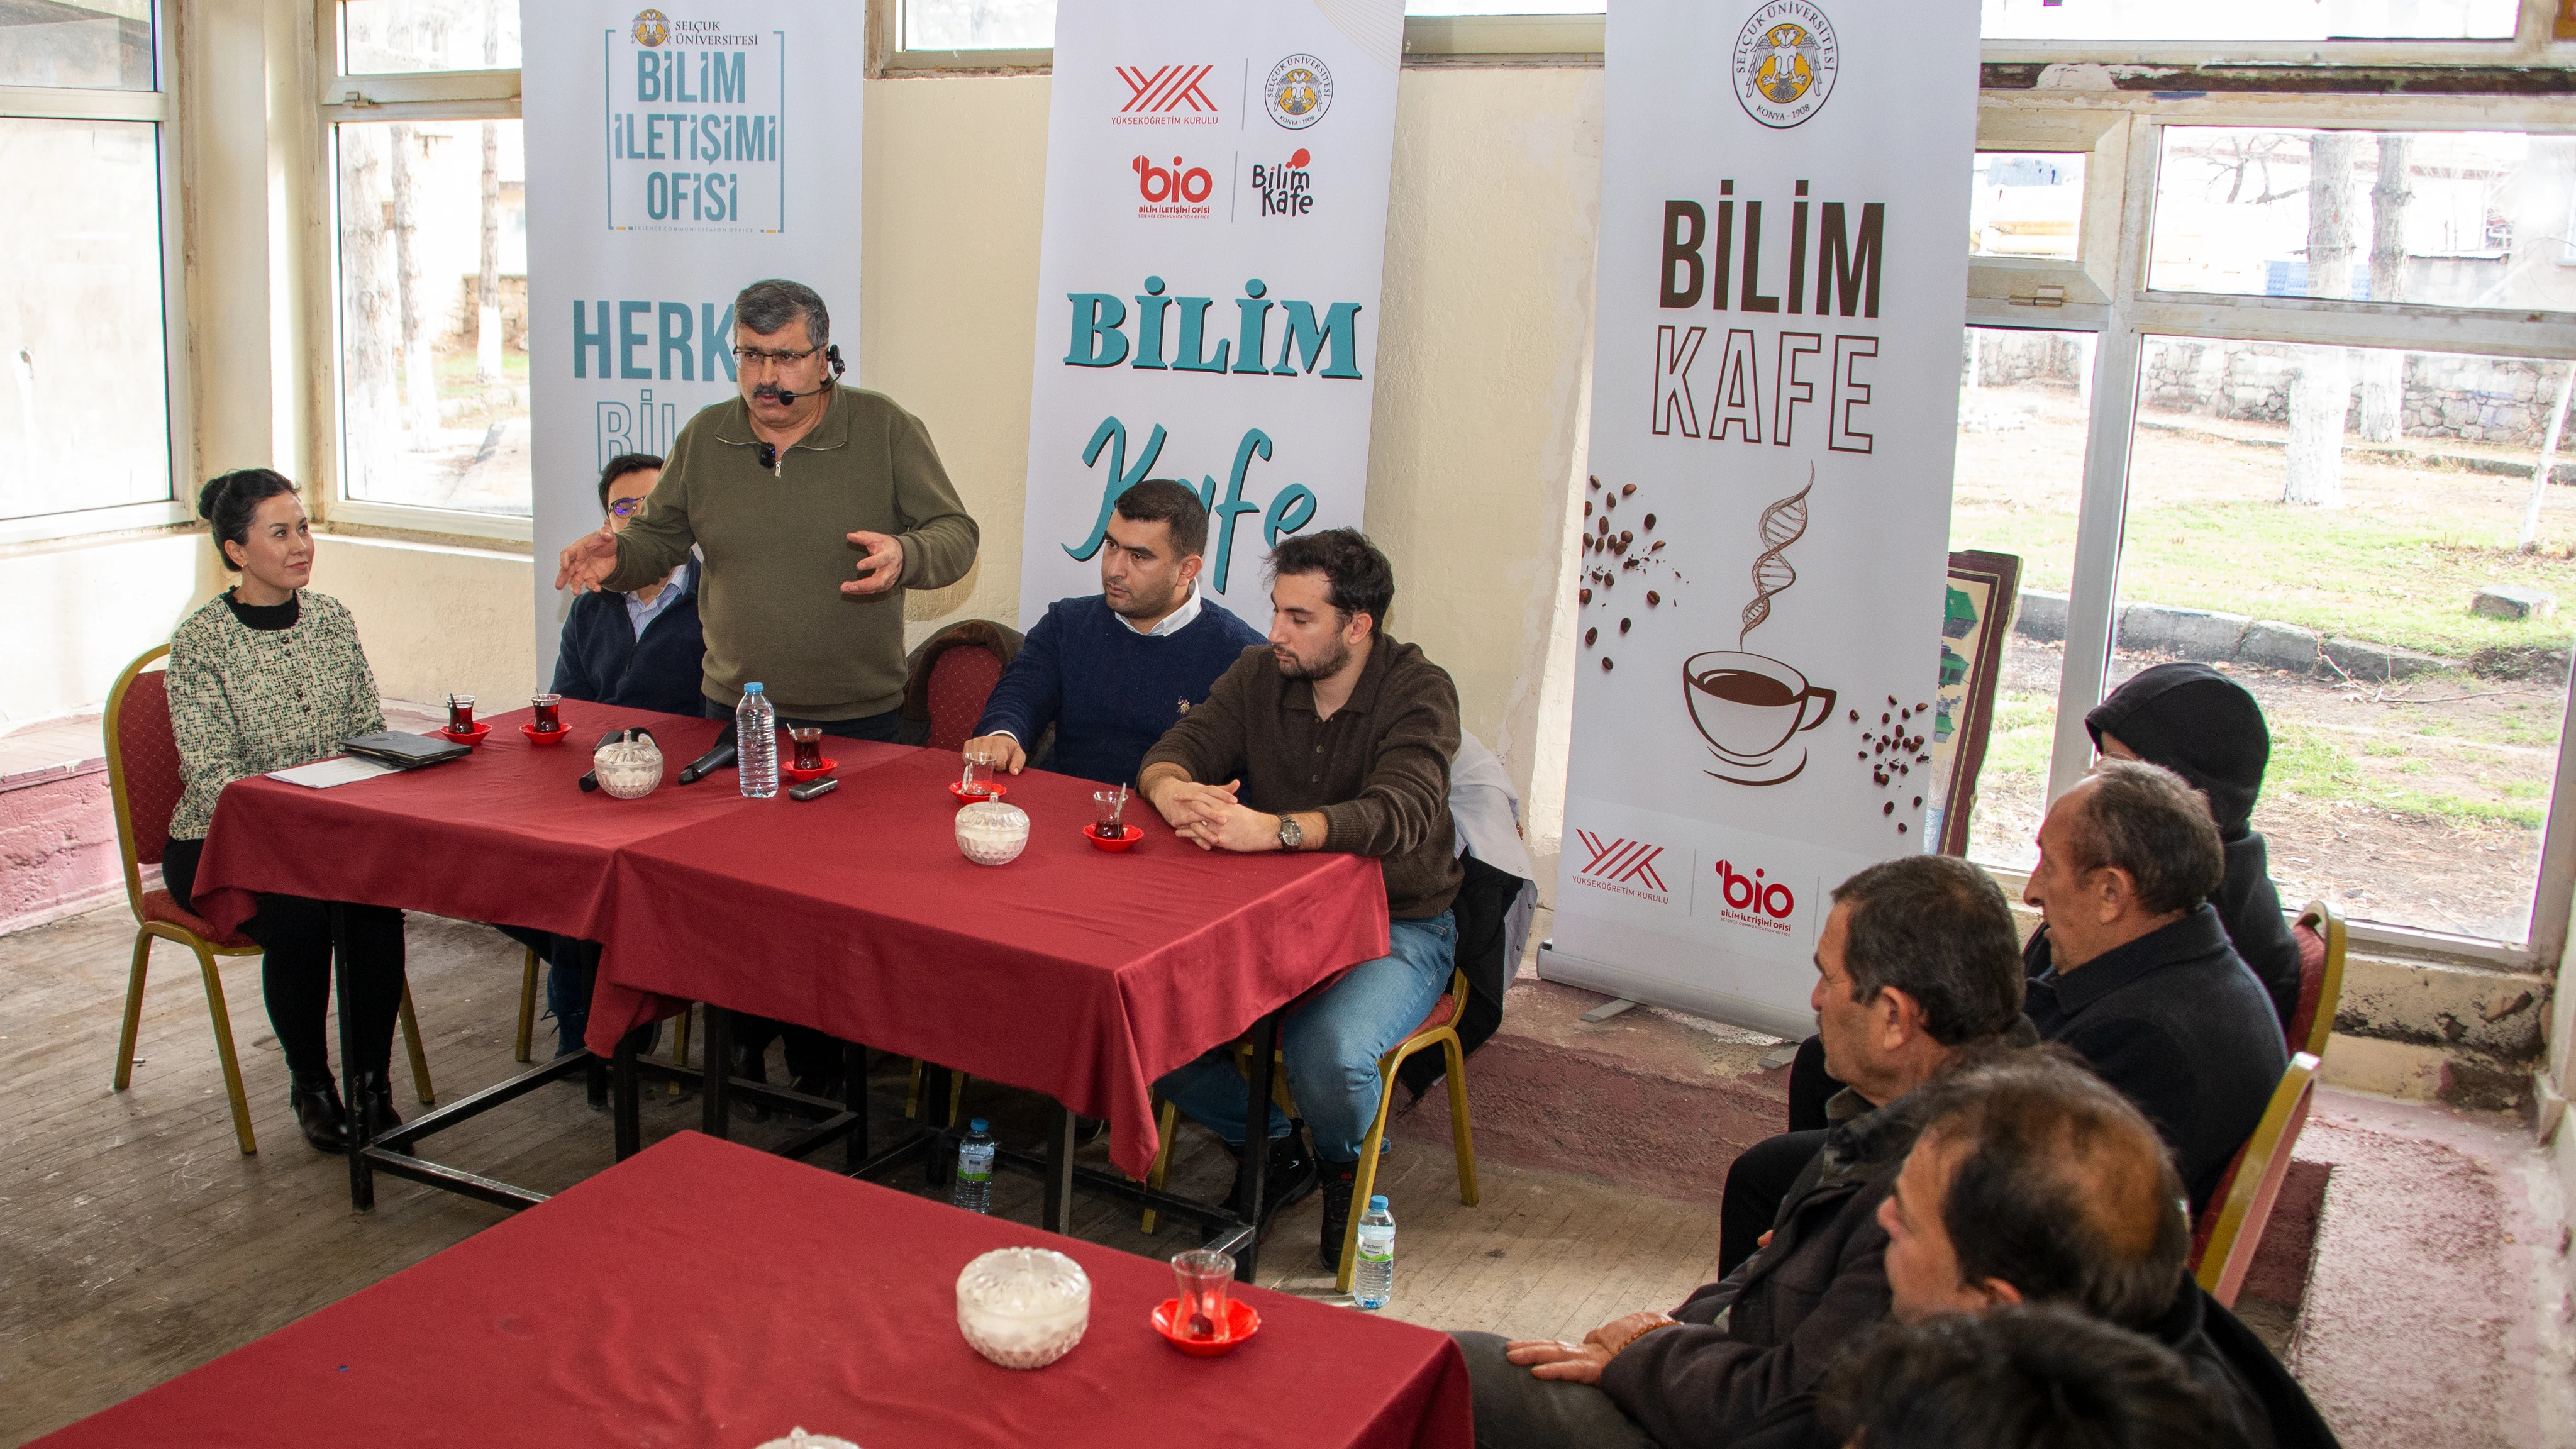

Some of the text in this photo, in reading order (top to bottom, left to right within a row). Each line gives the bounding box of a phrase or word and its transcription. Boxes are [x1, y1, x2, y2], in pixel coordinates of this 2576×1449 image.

[675, 21, 721, 33] SELÇUK
[675, 33, 758, 45] ÜNİVERSİTESİ
[1736, 1, 1835, 73] SELÇUK ÜNİVERSİTESİ
[637, 50, 745, 103] BİLİM
[1267, 64, 1287, 97] SELÇUK
[1111, 116, 1218, 125] YÜKSEKÖĞRETİM KURULU
[1279, 115, 1298, 125] KONYA
[1302, 115, 1315, 125] 1908
[1756, 104, 1785, 121] KONYA
[1792, 104, 1811, 119] 1908
[614, 113, 776, 165] İLETİŞİMİ
[1132, 155, 1213, 203] bio
[647, 172, 737, 221] OFİSİ
[1139, 204, 1210, 214] BİLİM İLETİŞİMİ OFİSİ
[1262, 184, 1313, 217] Kafe
[1660, 179, 1885, 319] BİLİM
[1063, 275, 1362, 380] BİLİM
[1652, 325, 1879, 454] KAFE
[1061, 416, 1318, 595] Kfe
[1572, 875, 1669, 904] YÜKSEKÖĞRETİM KURULU
[1715, 858, 1794, 919] bio
[1721, 909, 1792, 932] BİLİM İLETİŞİMİ OFİSİ
[1738, 922, 1775, 933] COMMUNICATION
